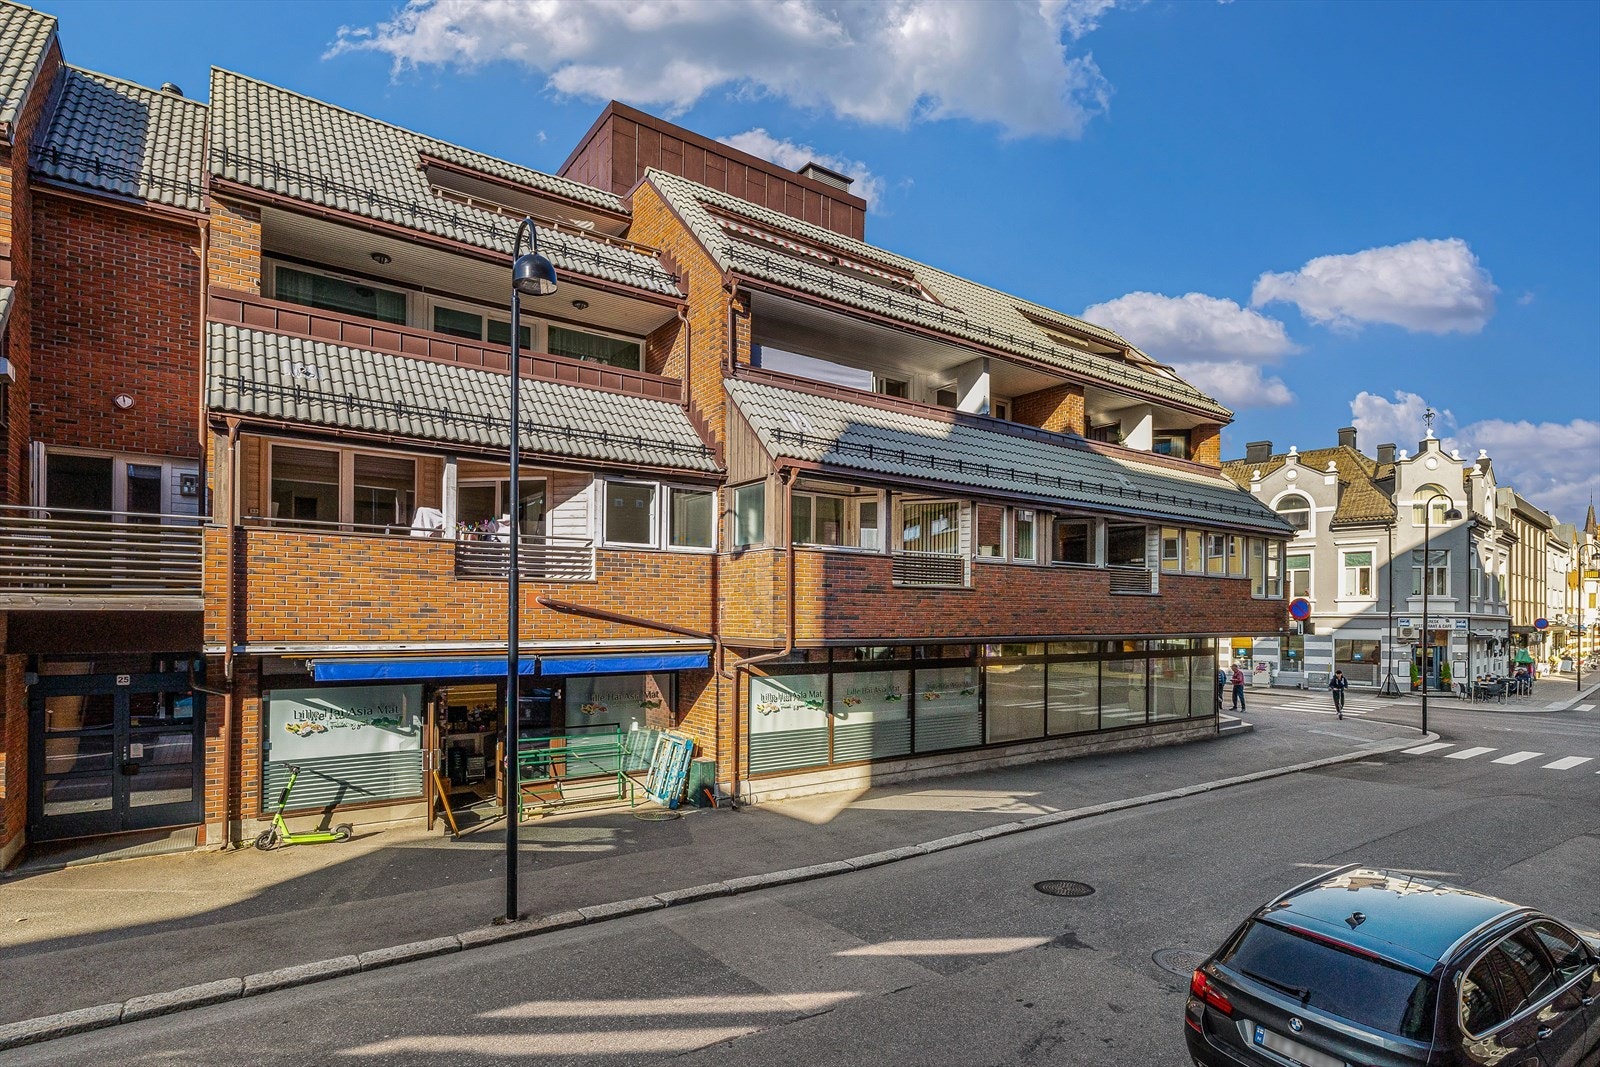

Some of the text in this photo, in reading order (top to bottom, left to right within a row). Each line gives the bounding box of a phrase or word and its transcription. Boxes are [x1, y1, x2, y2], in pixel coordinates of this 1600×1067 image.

[117, 676, 129, 684] 25
[643, 690, 659, 699] Mat
[792, 691, 807, 699] Asia
[808, 690, 823, 698] Mat
[293, 709, 325, 722] Lille
[348, 706, 373, 717] Asia
[377, 704, 399, 715] Mat
